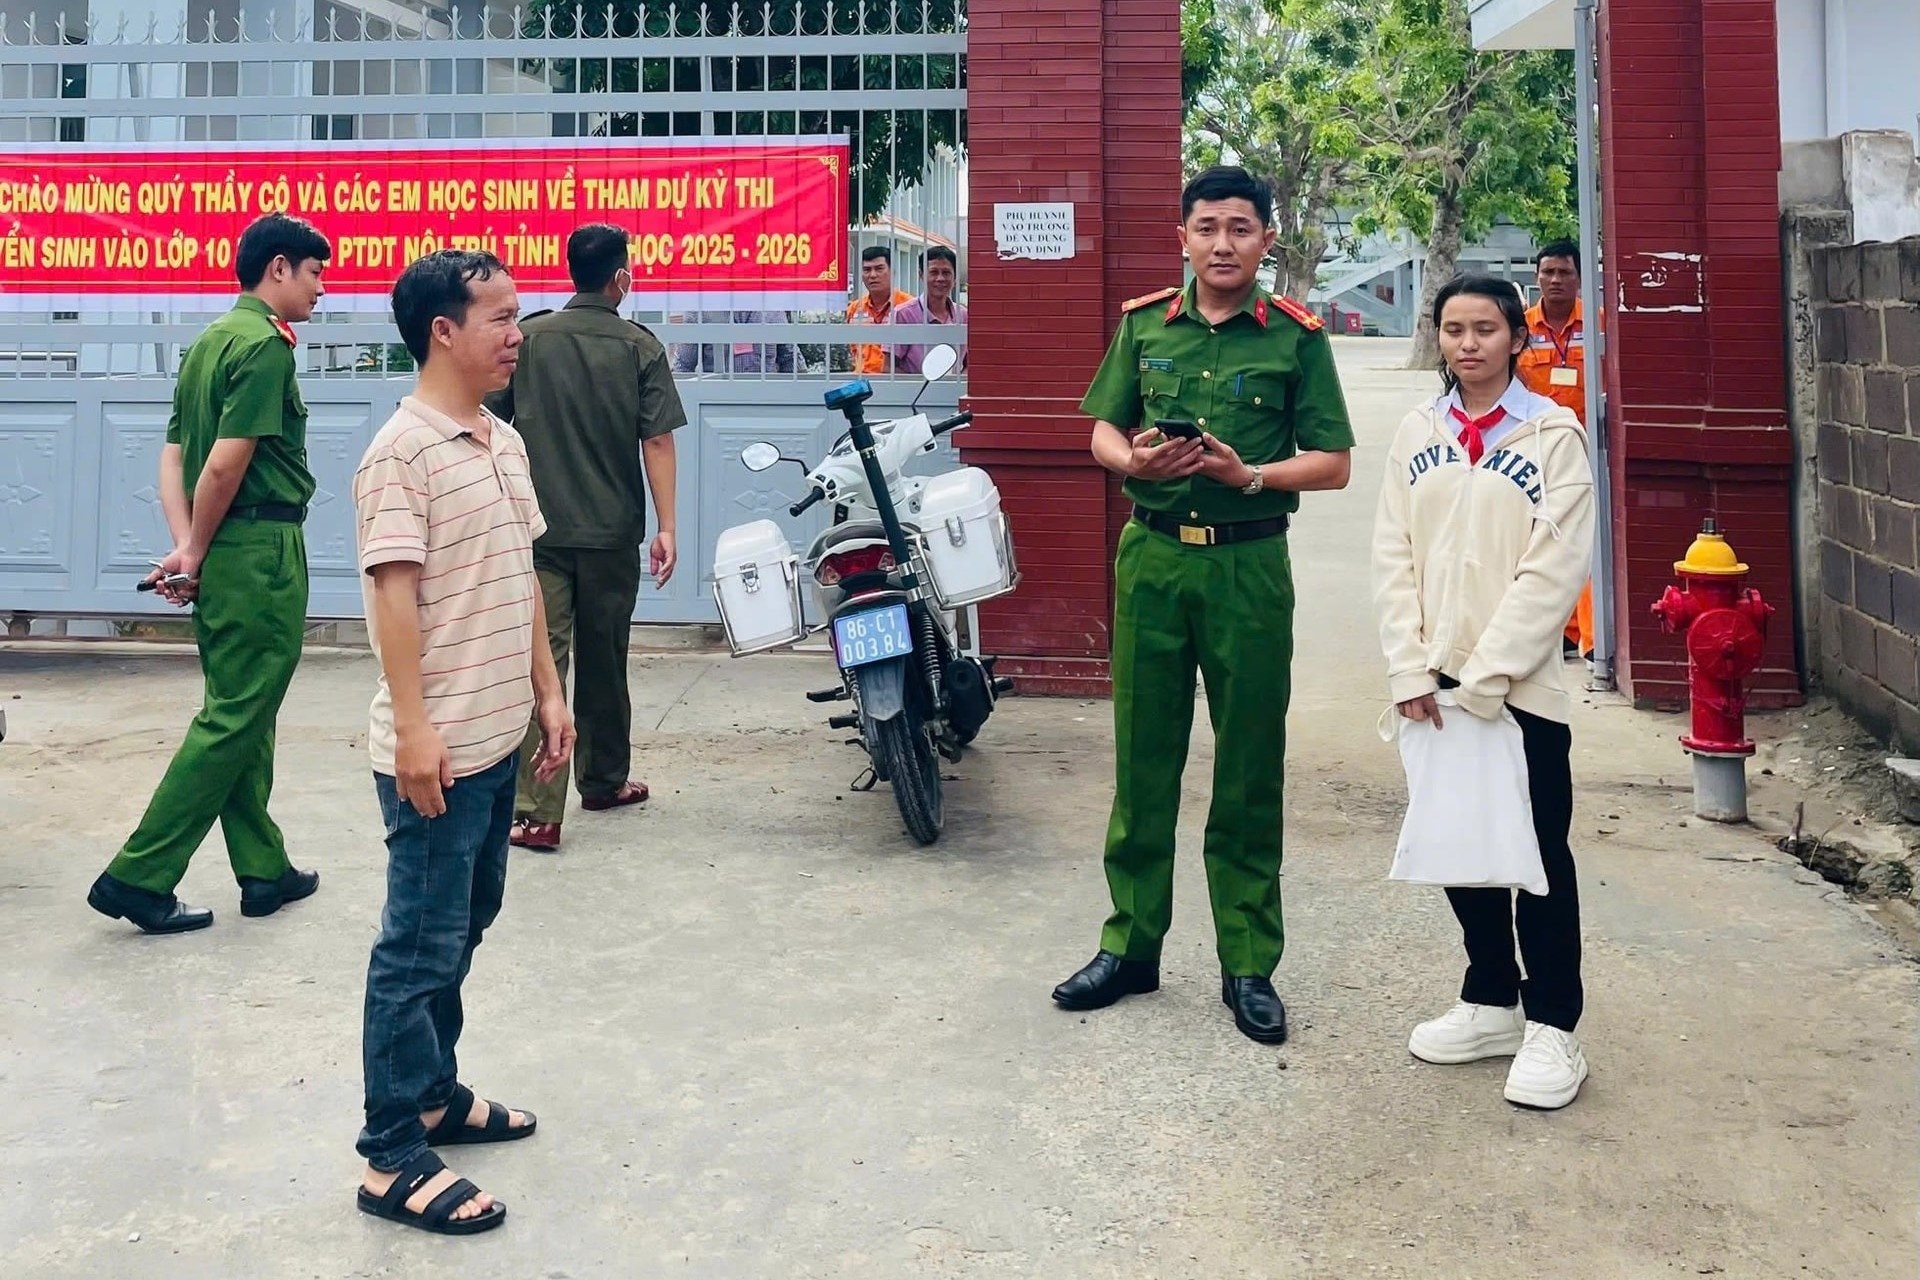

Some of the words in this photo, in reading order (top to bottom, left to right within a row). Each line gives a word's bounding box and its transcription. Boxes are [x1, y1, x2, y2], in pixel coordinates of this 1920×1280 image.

[0, 174, 58, 213] CHÀO
[64, 174, 130, 213] MỪNG
[137, 174, 184, 214] QUÝ
[191, 169, 252, 213] THẦY
[258, 174, 290, 213] CÔ
[297, 173, 327, 212] VÀ
[334, 173, 381, 212] CÁC
[387, 180, 421, 212] EM
[428, 179, 477, 220] HỌC
[483, 179, 538, 211] SINH
[545, 165, 576, 211] VỀ
[582, 178, 650, 210] THAM
[656, 174, 689, 218] DỰ
[695, 168, 728, 209] KỲ
[734, 177, 774, 208] THI
[41, 236, 96, 268] SINH
[103, 228, 148, 268] VÀO
[155, 228, 199, 268] LỚP
[205, 237, 231, 268] 10
[338, 236, 398, 268] PTDT
[504, 223, 560, 267] TỈNH
[627, 233, 674, 275] HỌC
[681, 233, 736, 265] 2025
[741, 248, 749, 257] -
[757, 233, 811, 265] 2026
[846, 610, 895, 640] 86-C1
[843, 631, 908, 664] 003.84
